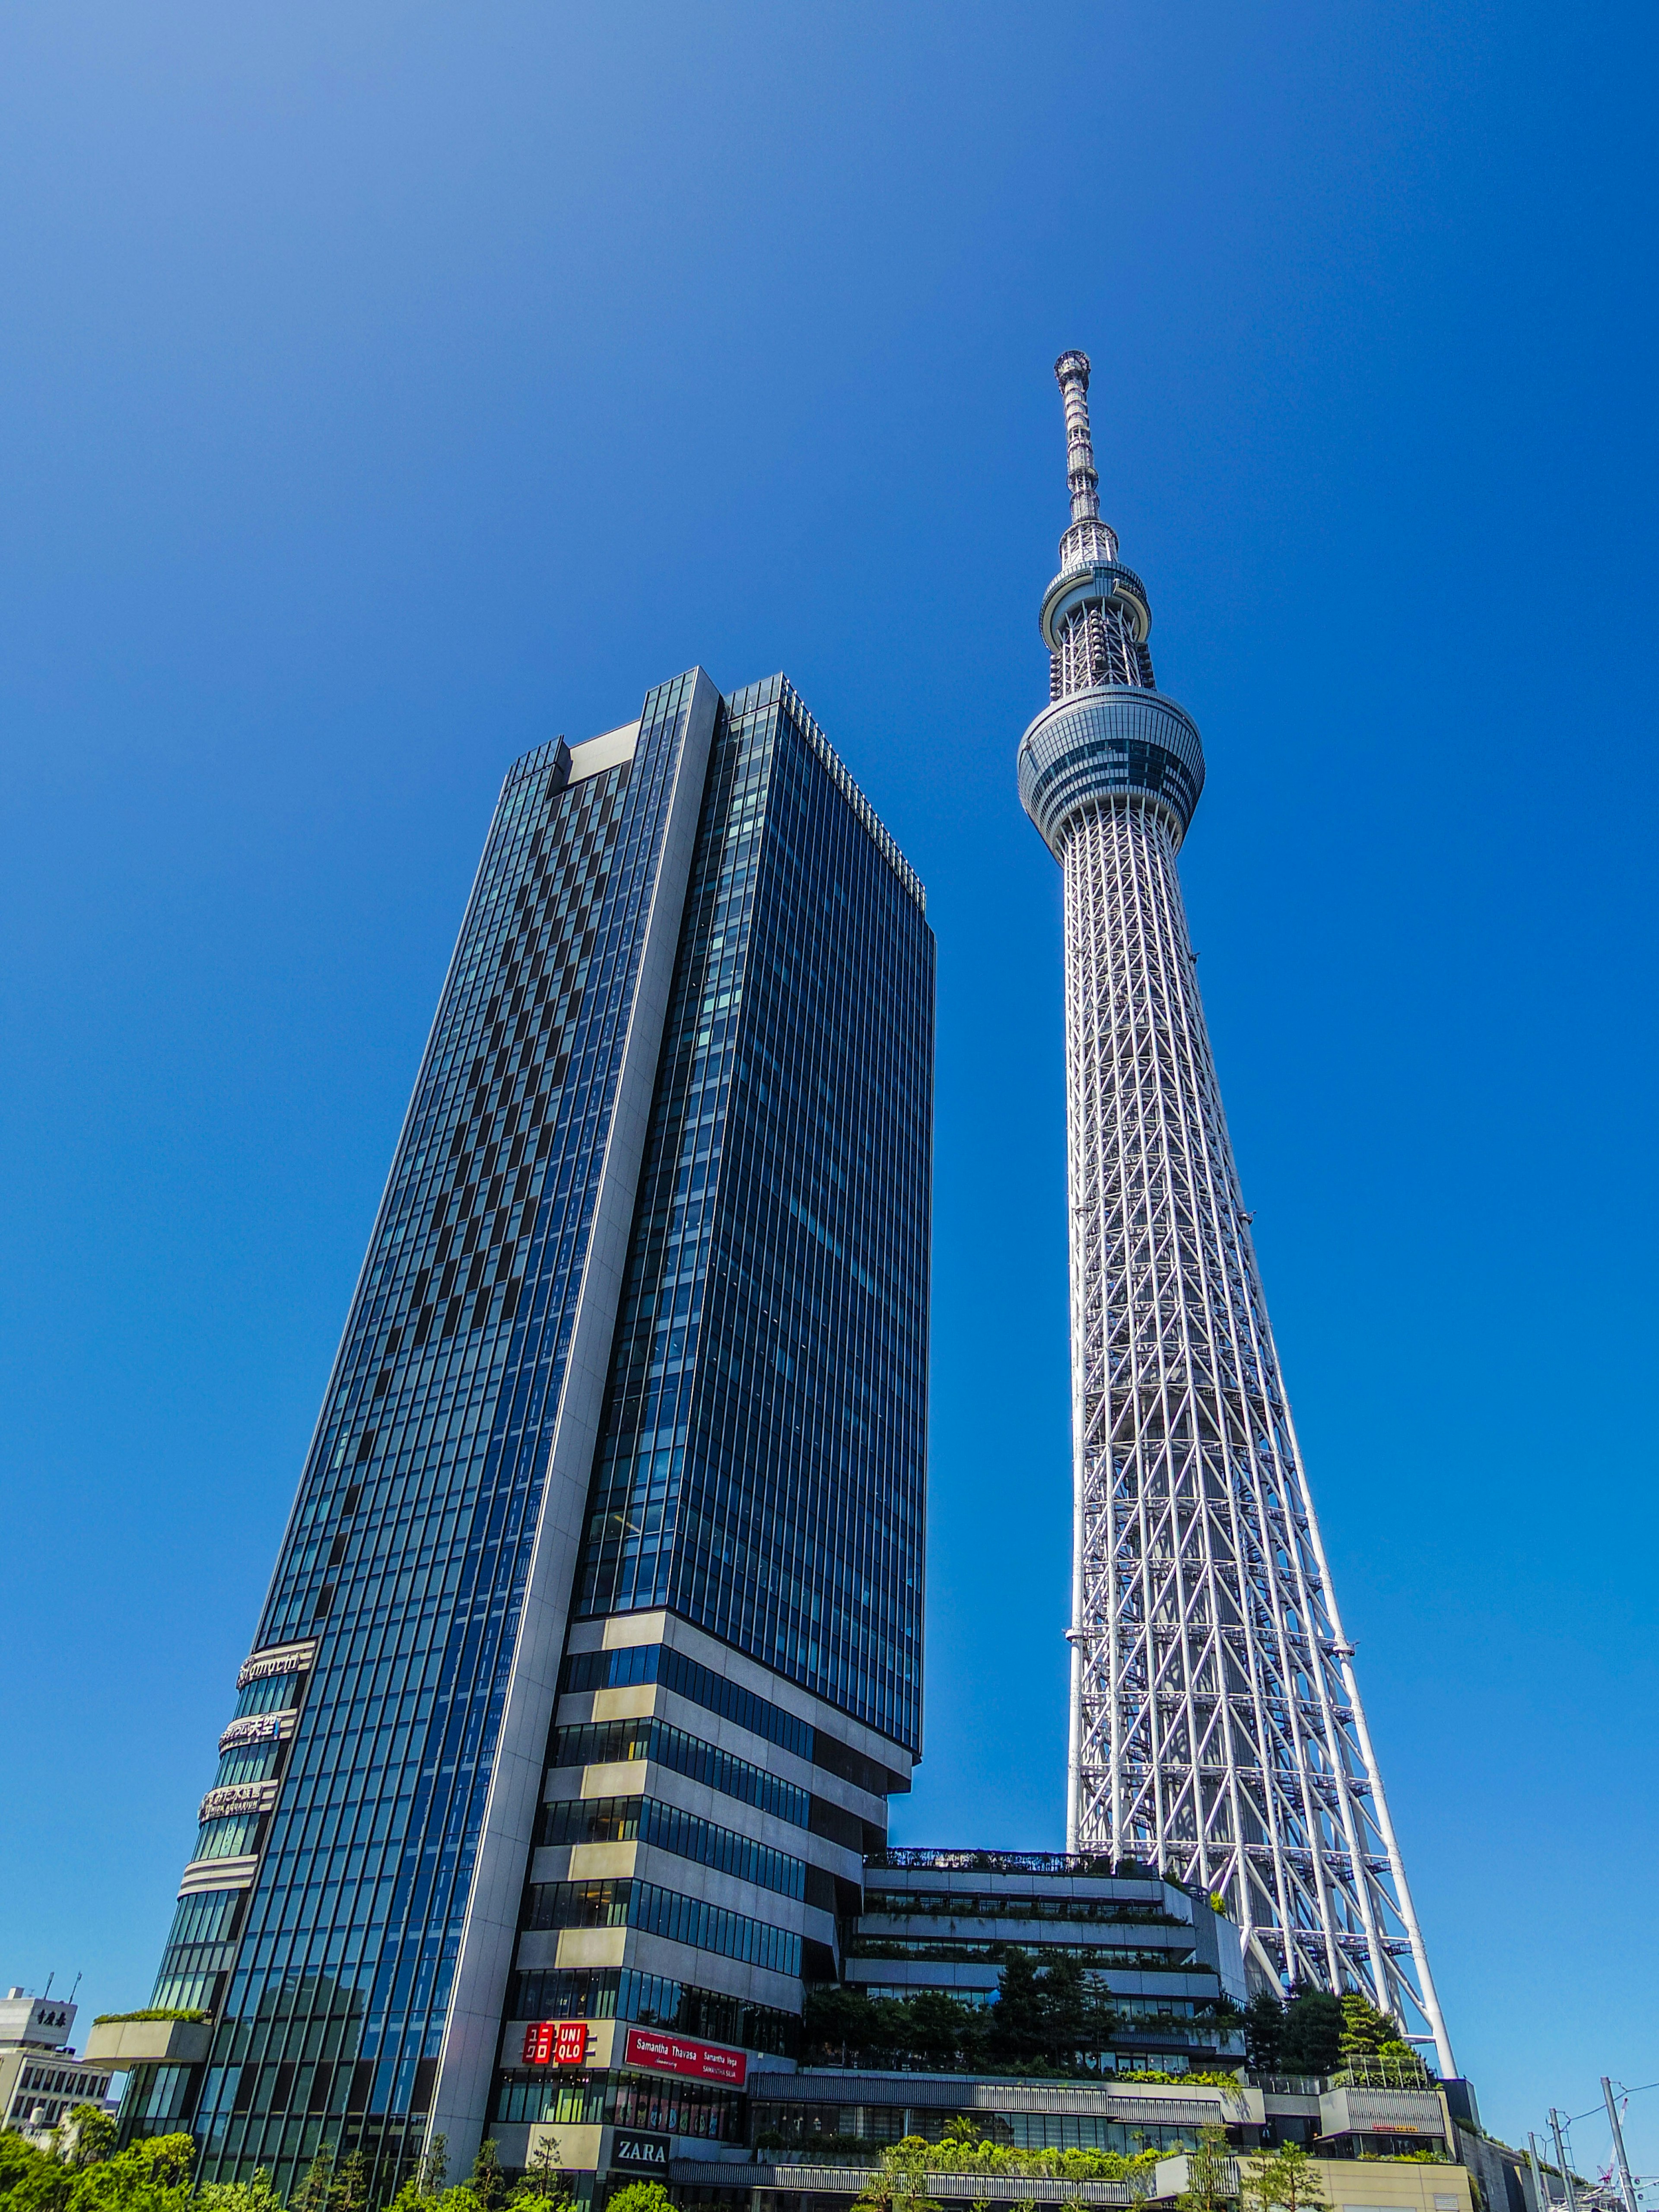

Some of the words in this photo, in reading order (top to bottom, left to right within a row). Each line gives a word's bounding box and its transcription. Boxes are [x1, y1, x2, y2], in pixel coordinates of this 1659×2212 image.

[226, 1800, 258, 1811] AQUARIUM
[561, 2028, 581, 2042] UNI
[559, 2044, 580, 2060] QLO
[637, 2038, 668, 2055] Samantha
[672, 2045, 696, 2060] Thavasa
[704, 2051, 725, 2063] Samantha
[727, 2056, 737, 2067] Vega
[618, 2141, 666, 2163] ZARA
